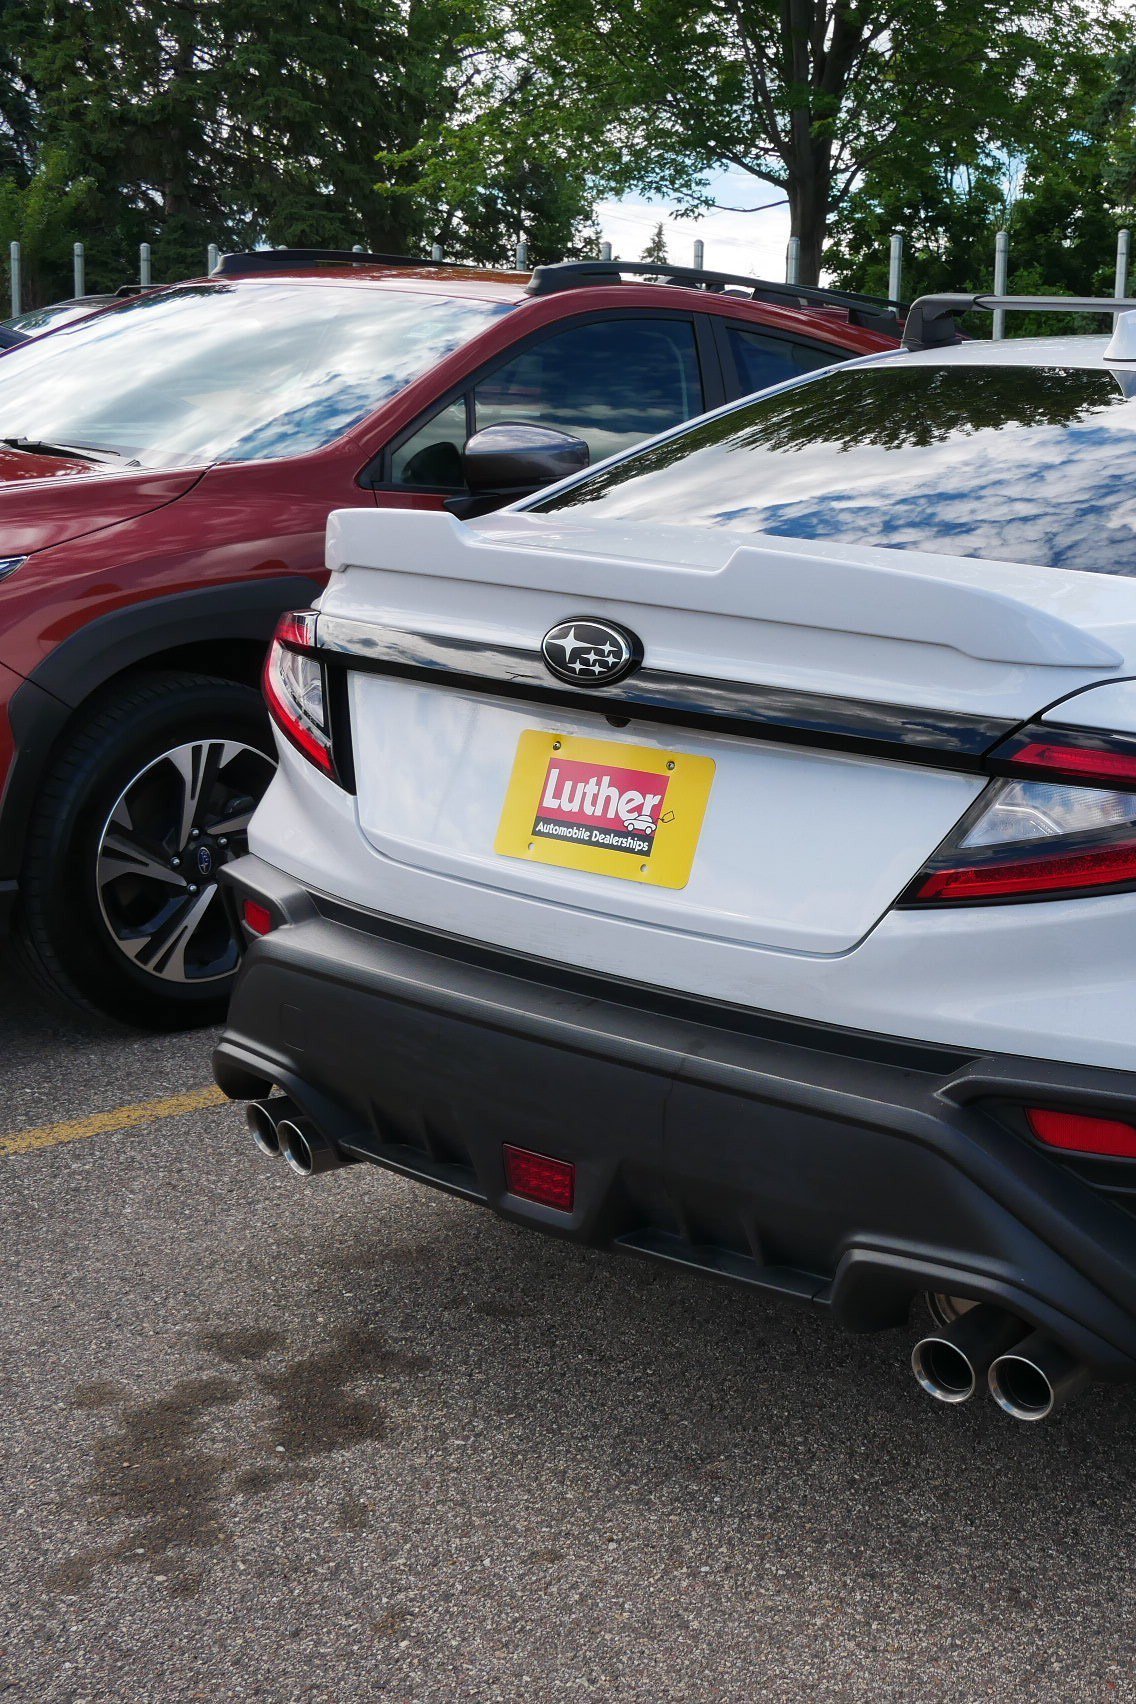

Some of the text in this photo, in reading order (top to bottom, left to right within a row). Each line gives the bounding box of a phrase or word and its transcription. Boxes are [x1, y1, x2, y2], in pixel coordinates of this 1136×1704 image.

[543, 768, 661, 820] Luther
[536, 821, 649, 852] Automobile Dealerships
